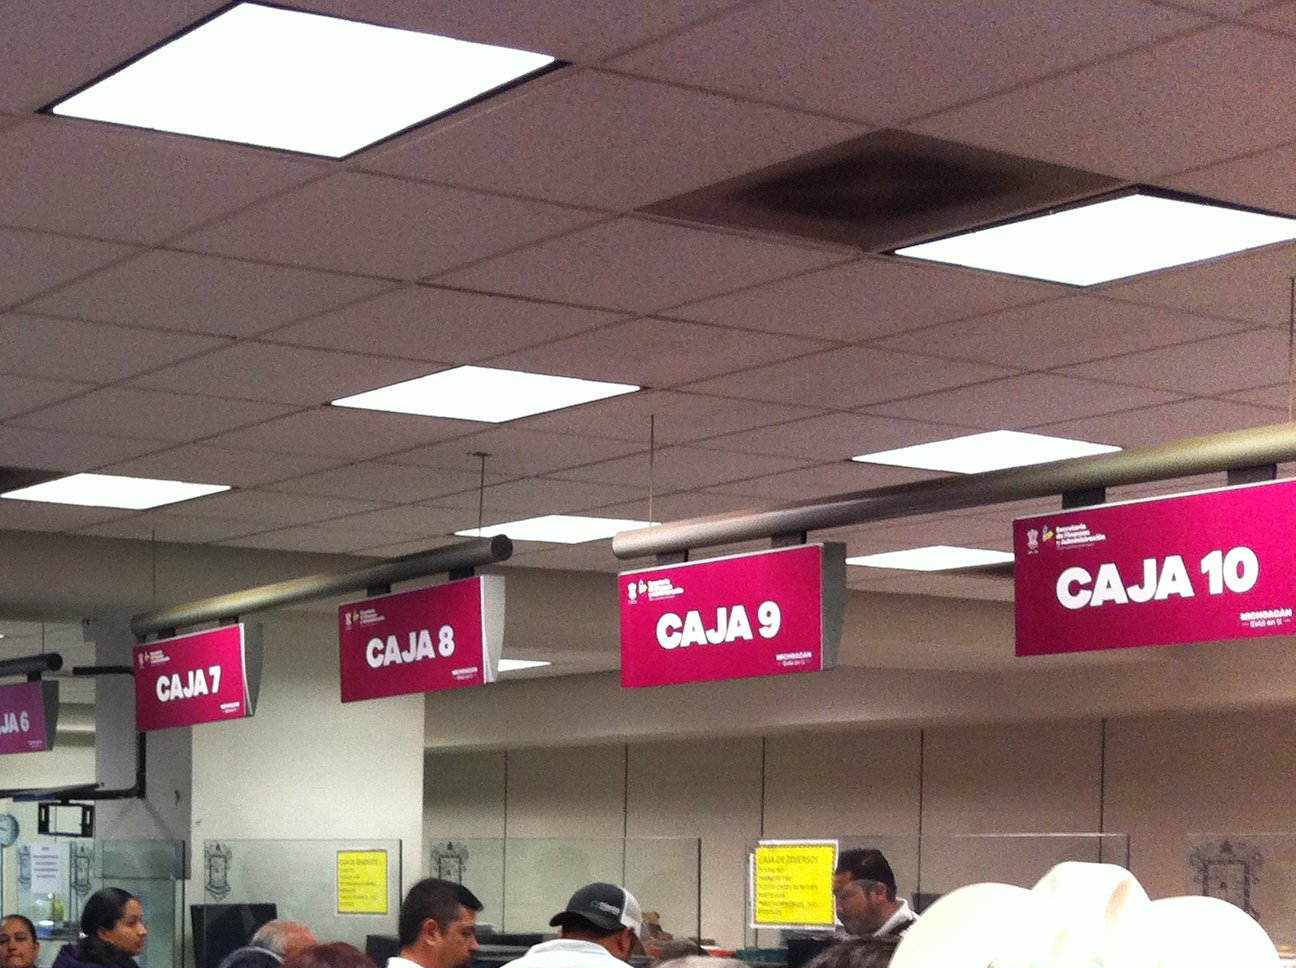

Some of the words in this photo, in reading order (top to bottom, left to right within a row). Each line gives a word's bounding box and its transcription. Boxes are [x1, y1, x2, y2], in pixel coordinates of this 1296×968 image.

[1055, 555, 1195, 610] CAJA
[1201, 546, 1260, 594] 10
[365, 628, 436, 669] CAJA
[437, 624, 456, 657] 8
[655, 604, 754, 650] CAJA
[757, 600, 782, 639] 9
[156, 668, 209, 703] CAJA
[208, 665, 222, 694] 7
[20, 710, 30, 732] 6
